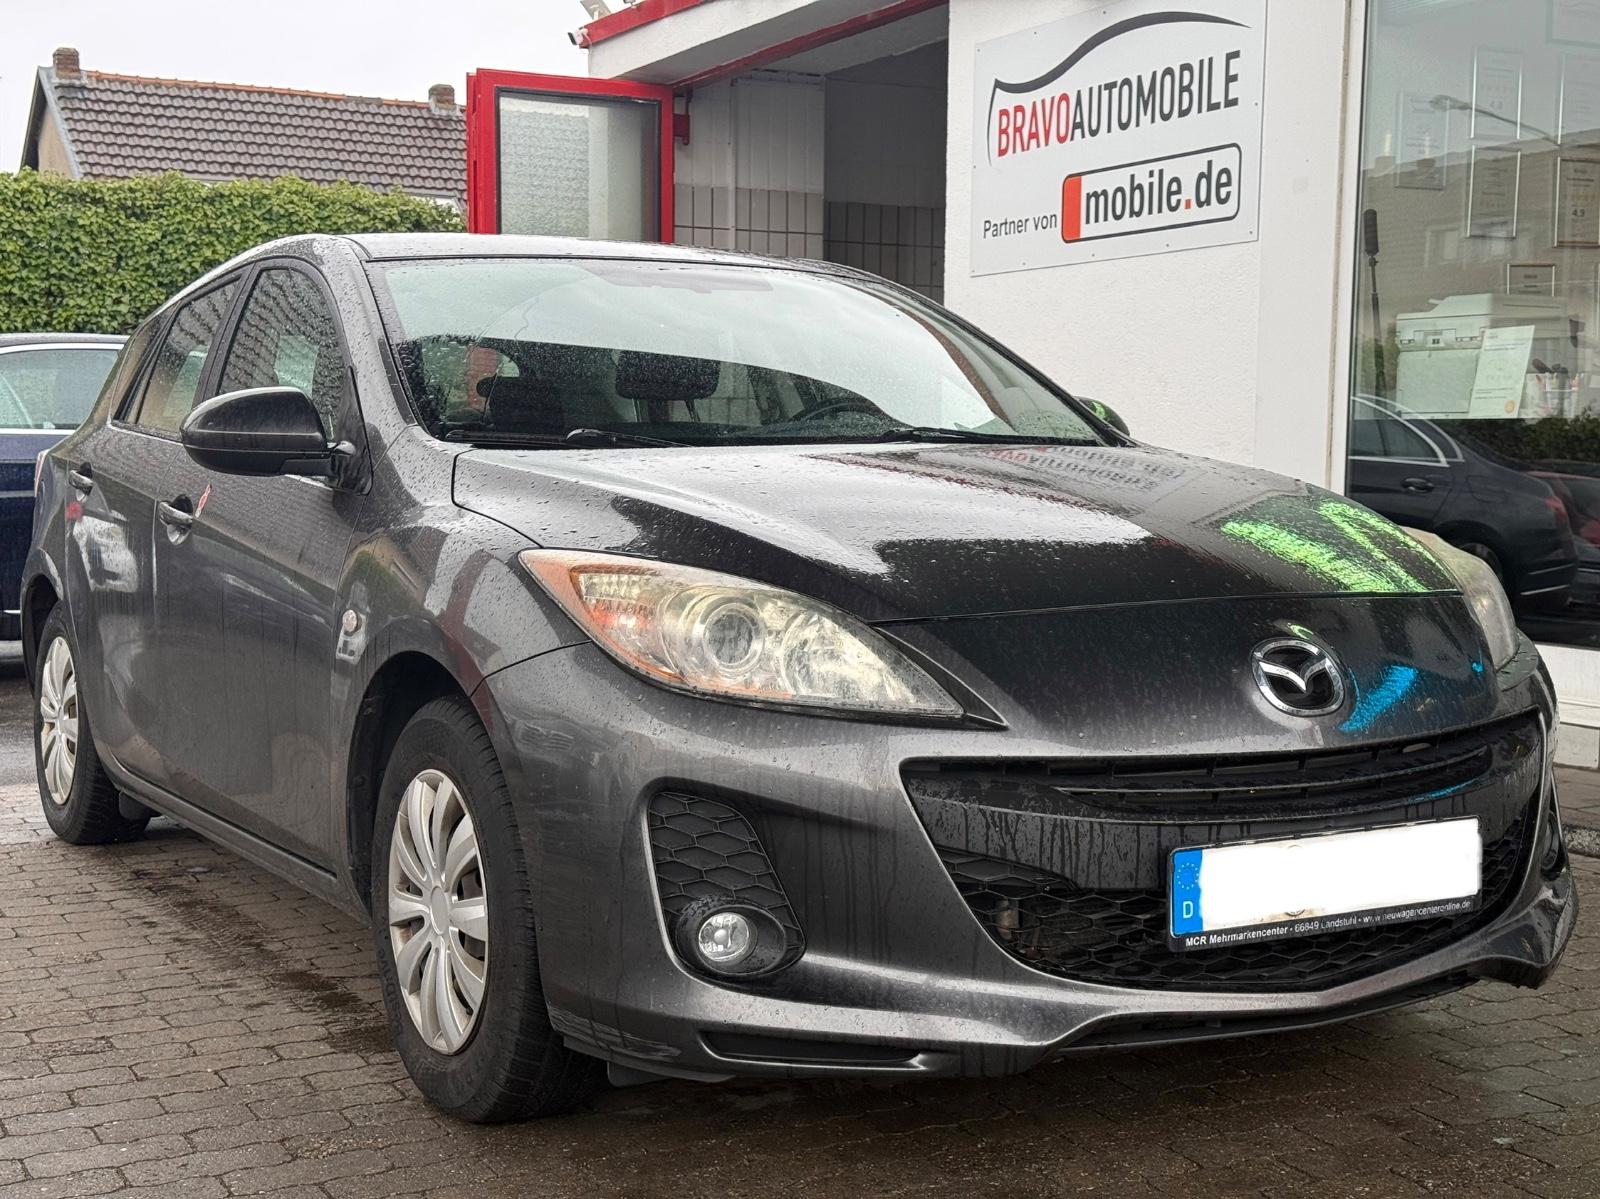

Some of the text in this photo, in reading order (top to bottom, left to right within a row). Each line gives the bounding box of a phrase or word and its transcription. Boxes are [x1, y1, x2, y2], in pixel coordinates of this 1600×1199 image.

[997, 49, 1241, 157] BRAVOAUTOMOBILE
[983, 160, 1233, 240] Partner von mobile.de
[1182, 900, 1194, 919] D
[1185, 935, 1207, 947] MCR
[1210, 925, 1288, 945] Mehrmarkencenter
[1294, 920, 1319, 933] 66849
